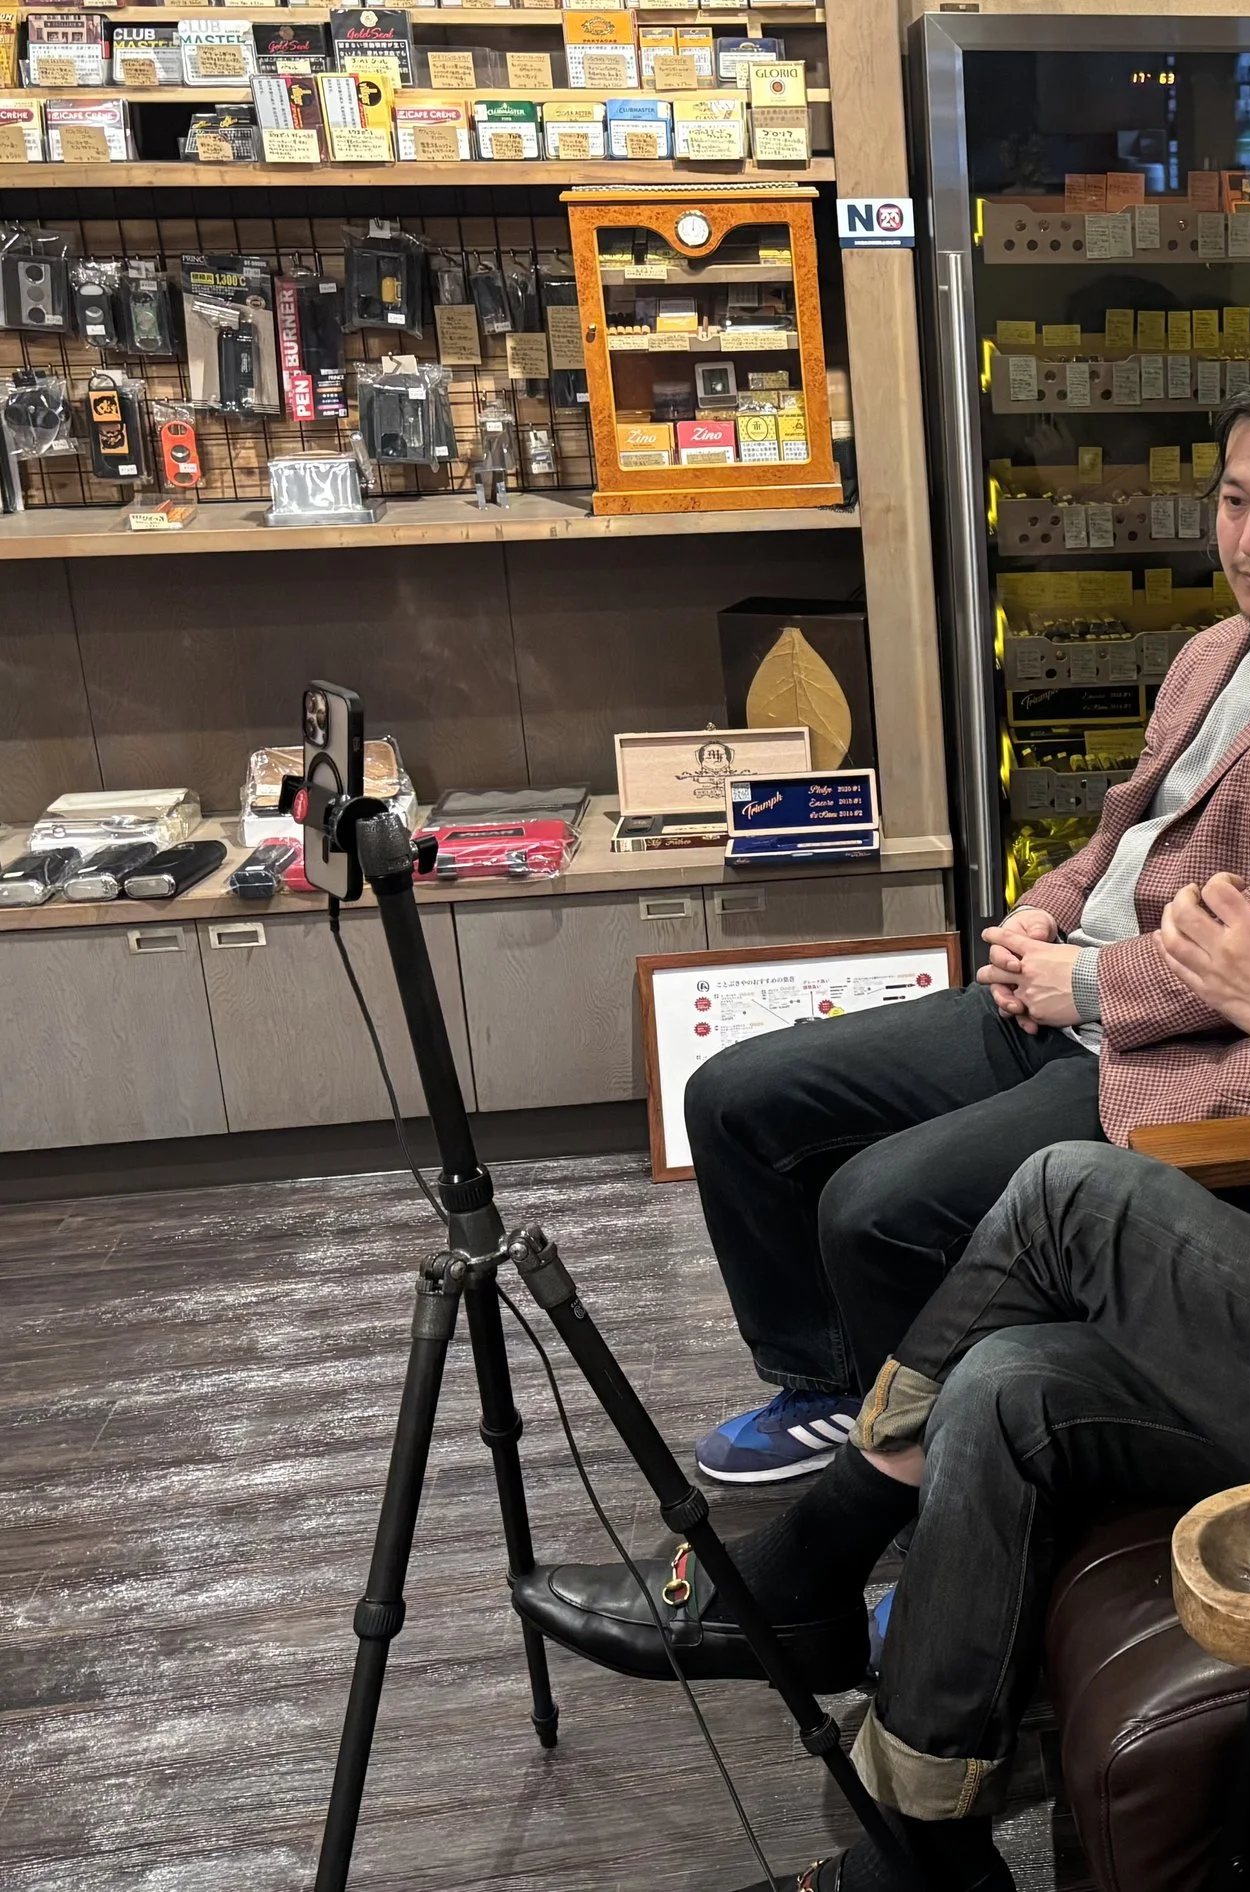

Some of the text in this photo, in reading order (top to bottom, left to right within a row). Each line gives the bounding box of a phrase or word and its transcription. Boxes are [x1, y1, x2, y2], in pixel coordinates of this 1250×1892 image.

[113, 28, 156, 40] CLUB
[346, 28, 394, 39] Gold Seal
[268, 40, 289, 53] Gold
[280, 289, 299, 367] BURNER
[294, 379, 311, 418] PEN
[627, 429, 657, 443] Zino
[690, 427, 723, 441] Zino
[742, 791, 783, 820] Triumph
